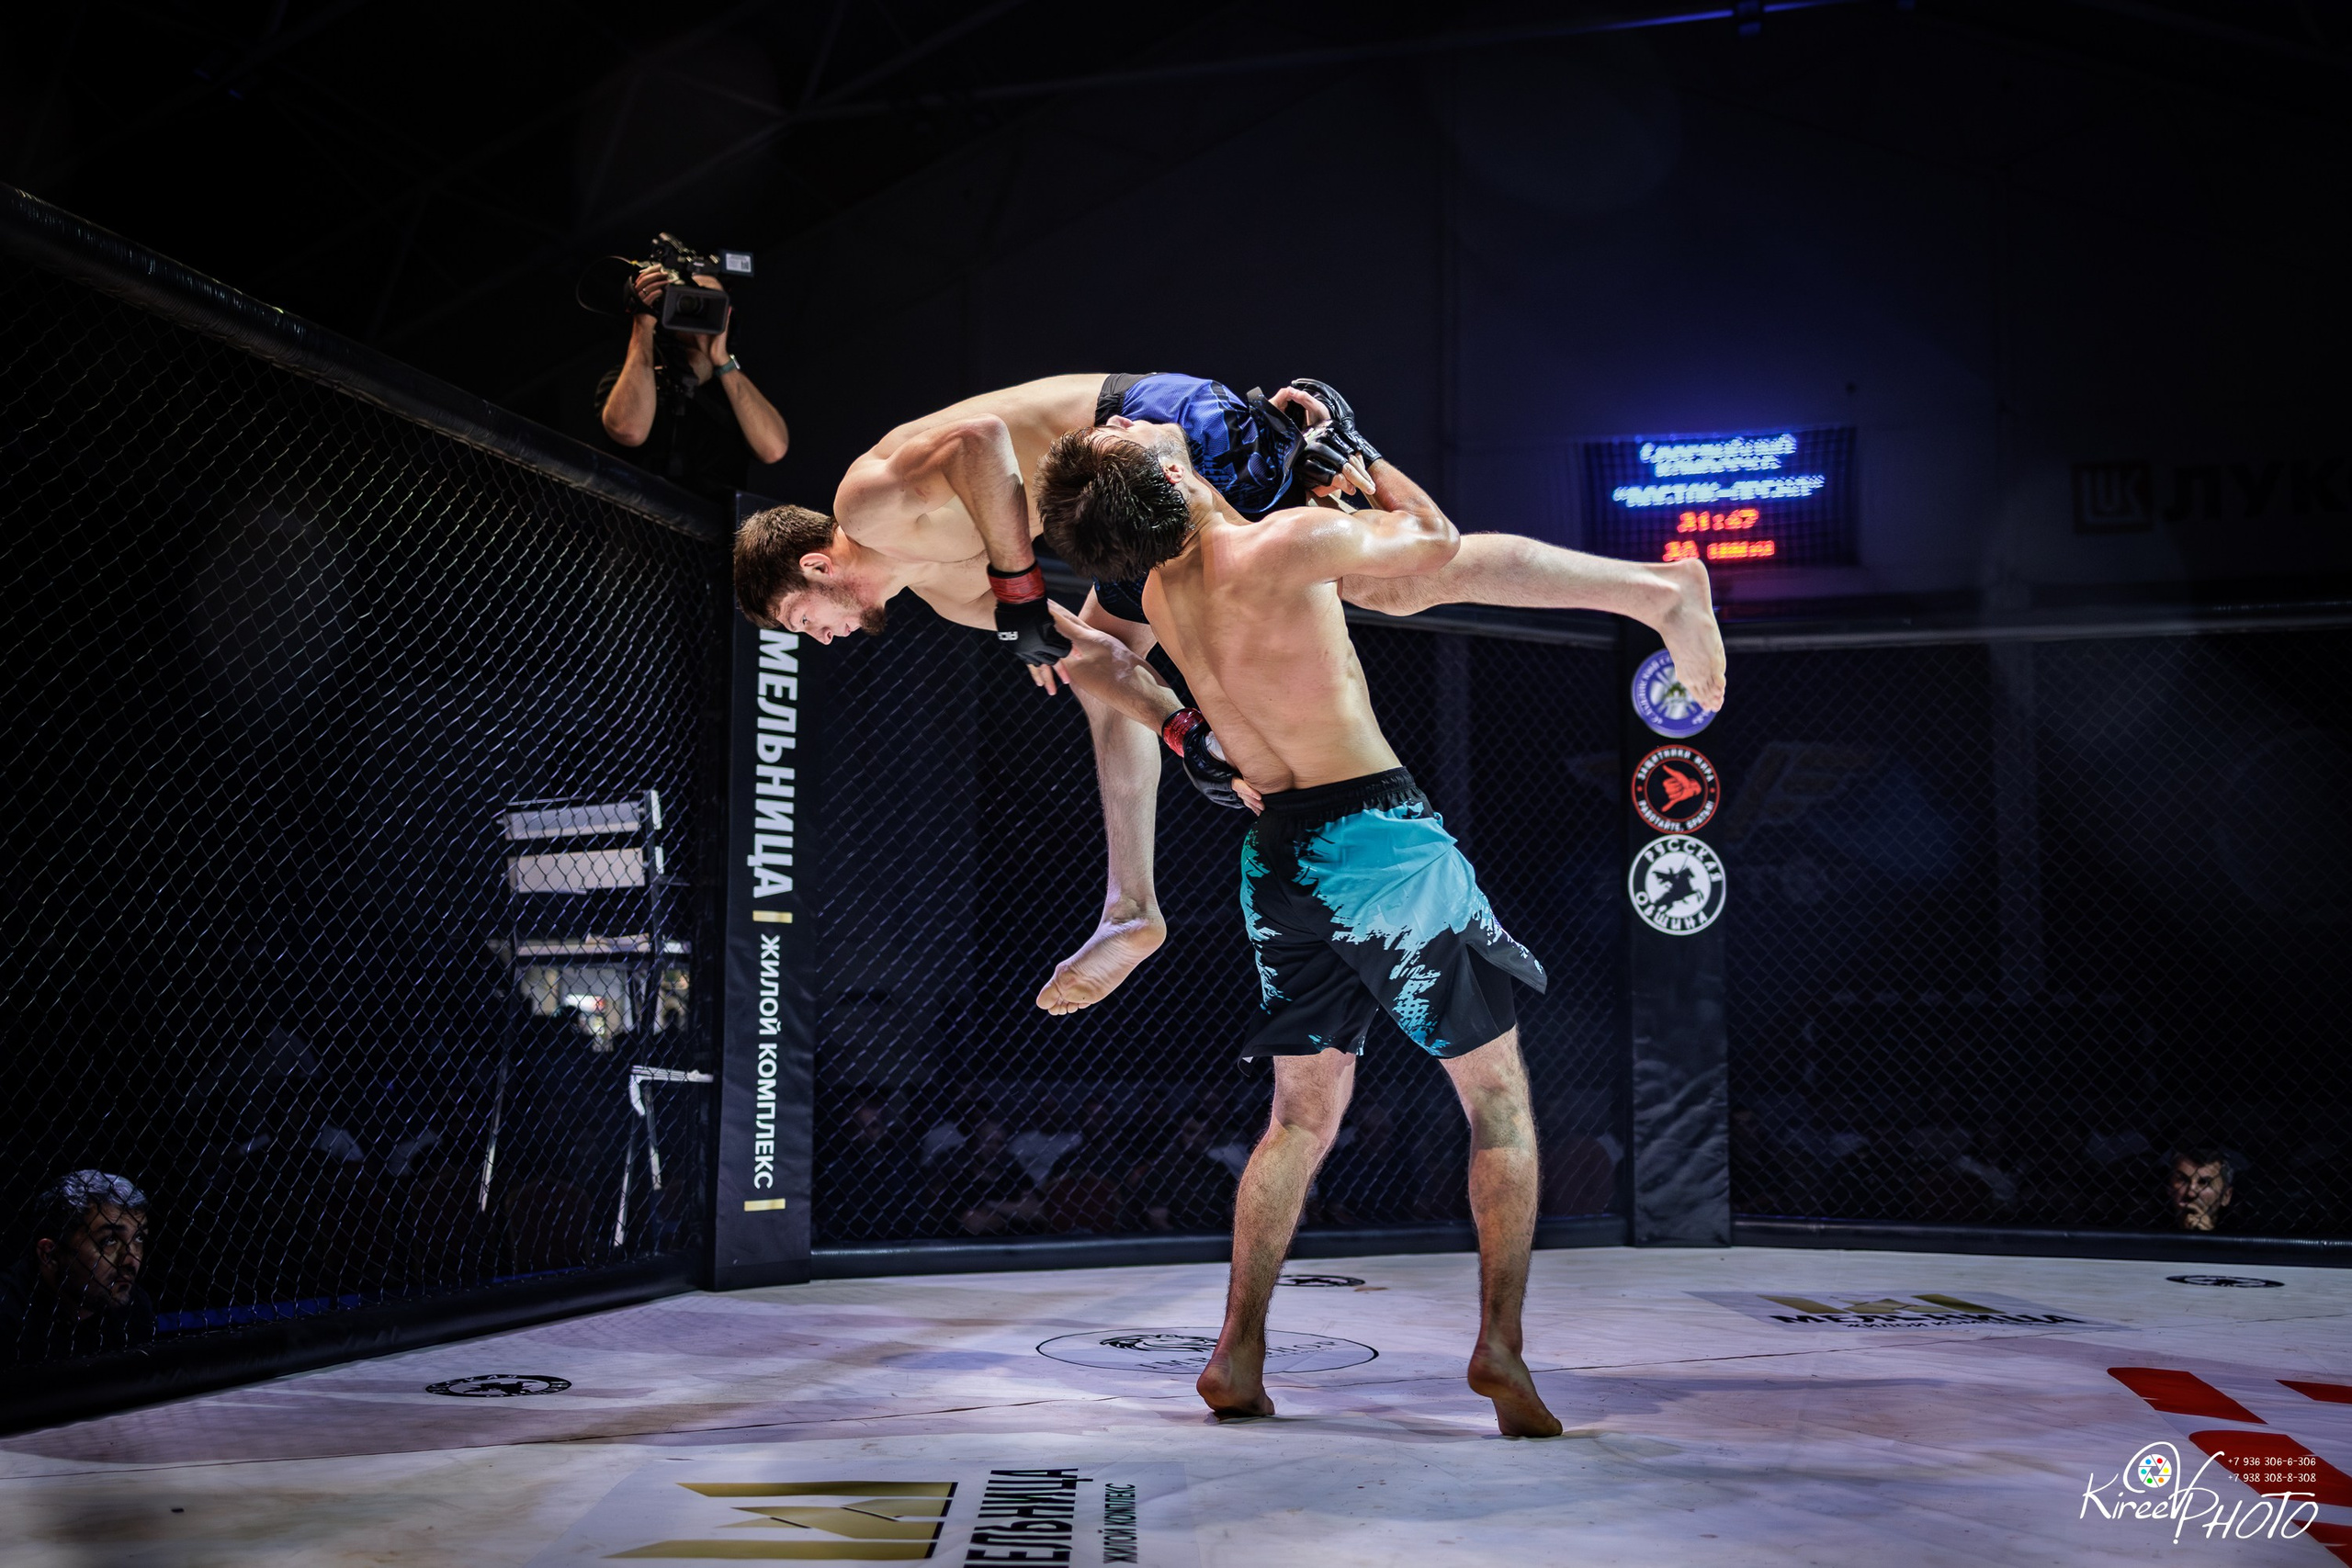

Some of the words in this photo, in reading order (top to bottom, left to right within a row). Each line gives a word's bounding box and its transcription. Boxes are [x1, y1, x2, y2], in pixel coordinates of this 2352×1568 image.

[2164, 459, 2352, 521] ЛУК
[747, 628, 799, 898] МЕЛЬНИЦА
[1637, 748, 1691, 781] ЗАЩИТНИКИ
[1693, 755, 1714, 782] МИРА
[1638, 799, 1684, 832] РАБОТАЙТЕ,
[1644, 838, 1723, 883] РУССКАЯ
[1635, 891, 1709, 931] ОБЩИНА
[759, 933, 782, 1035] ЖИЛОЙ
[753, 1043, 778, 1190] КОМПЛЕКС
[964, 1468, 1093, 1568] ЕЛЬНИЦА
[1103, 1483, 1137, 1526] КОМПЛЕКС
[1102, 1528, 1137, 1563] ЖИЛОЙ
